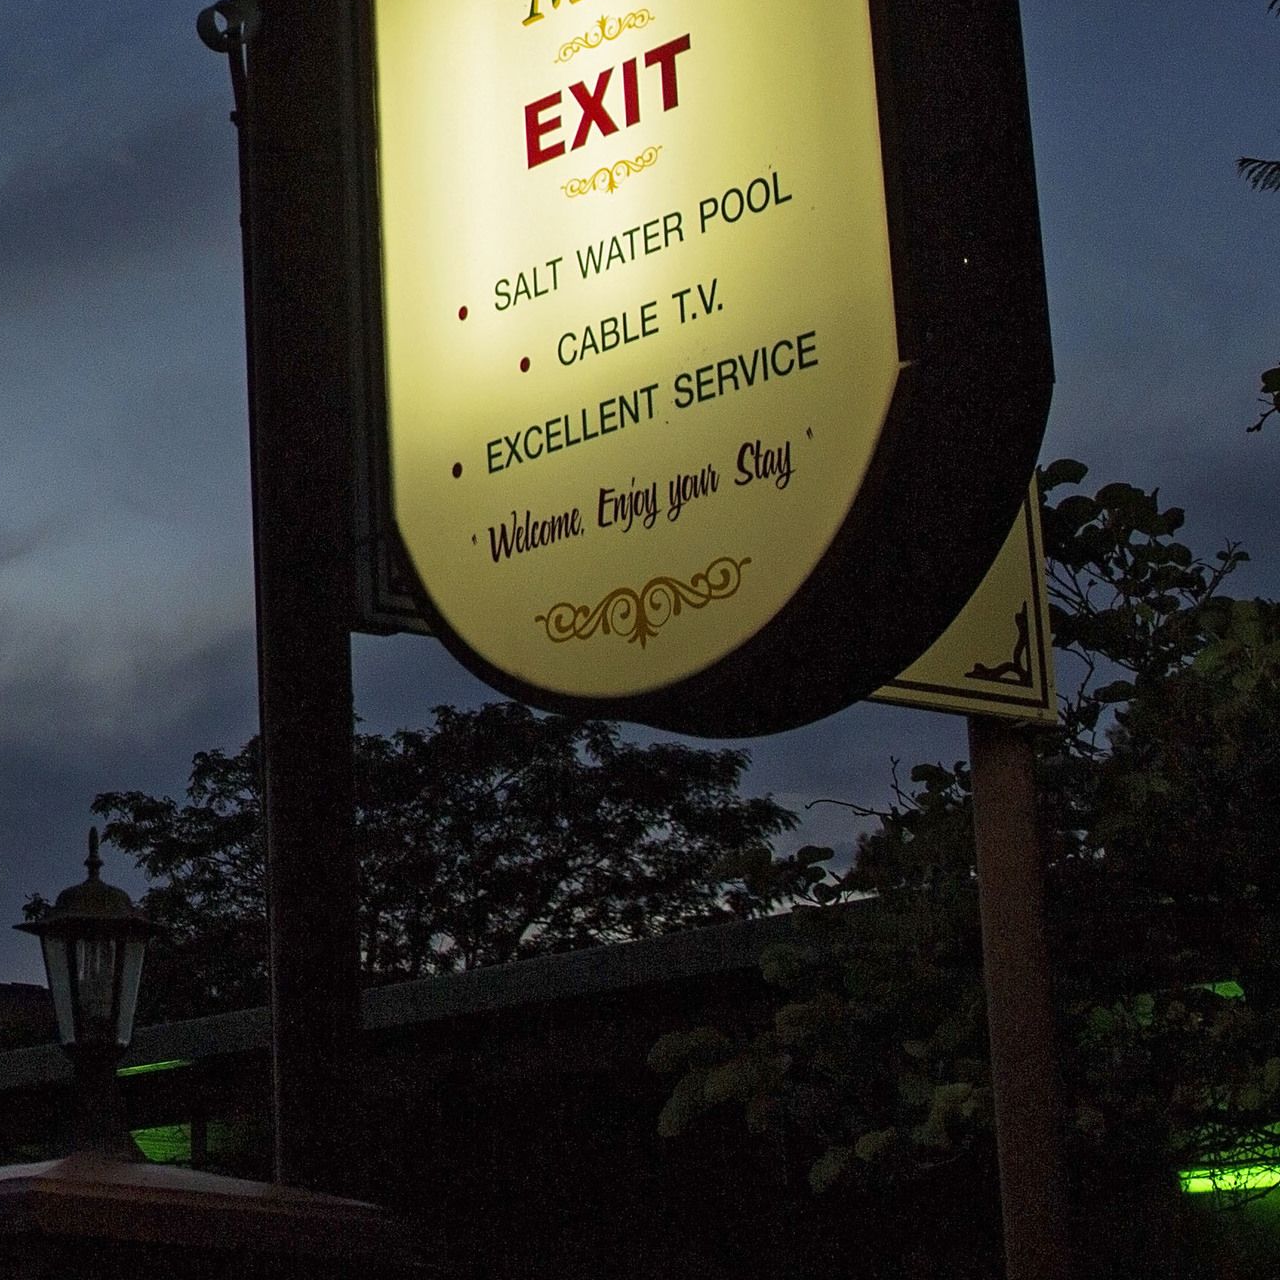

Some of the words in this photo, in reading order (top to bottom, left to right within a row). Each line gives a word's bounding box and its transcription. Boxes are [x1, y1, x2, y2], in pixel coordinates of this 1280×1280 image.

[524, 33, 692, 170] EXIT
[494, 257, 564, 311] SALT
[576, 211, 684, 280] WATER
[699, 170, 793, 234] POOL
[557, 301, 660, 367] CABLE
[671, 277, 724, 324] T.V.
[486, 383, 660, 474] EXCELLENT
[673, 330, 819, 409] SERVICE
[598, 477, 662, 534] Enjoy
[667, 463, 721, 522] your
